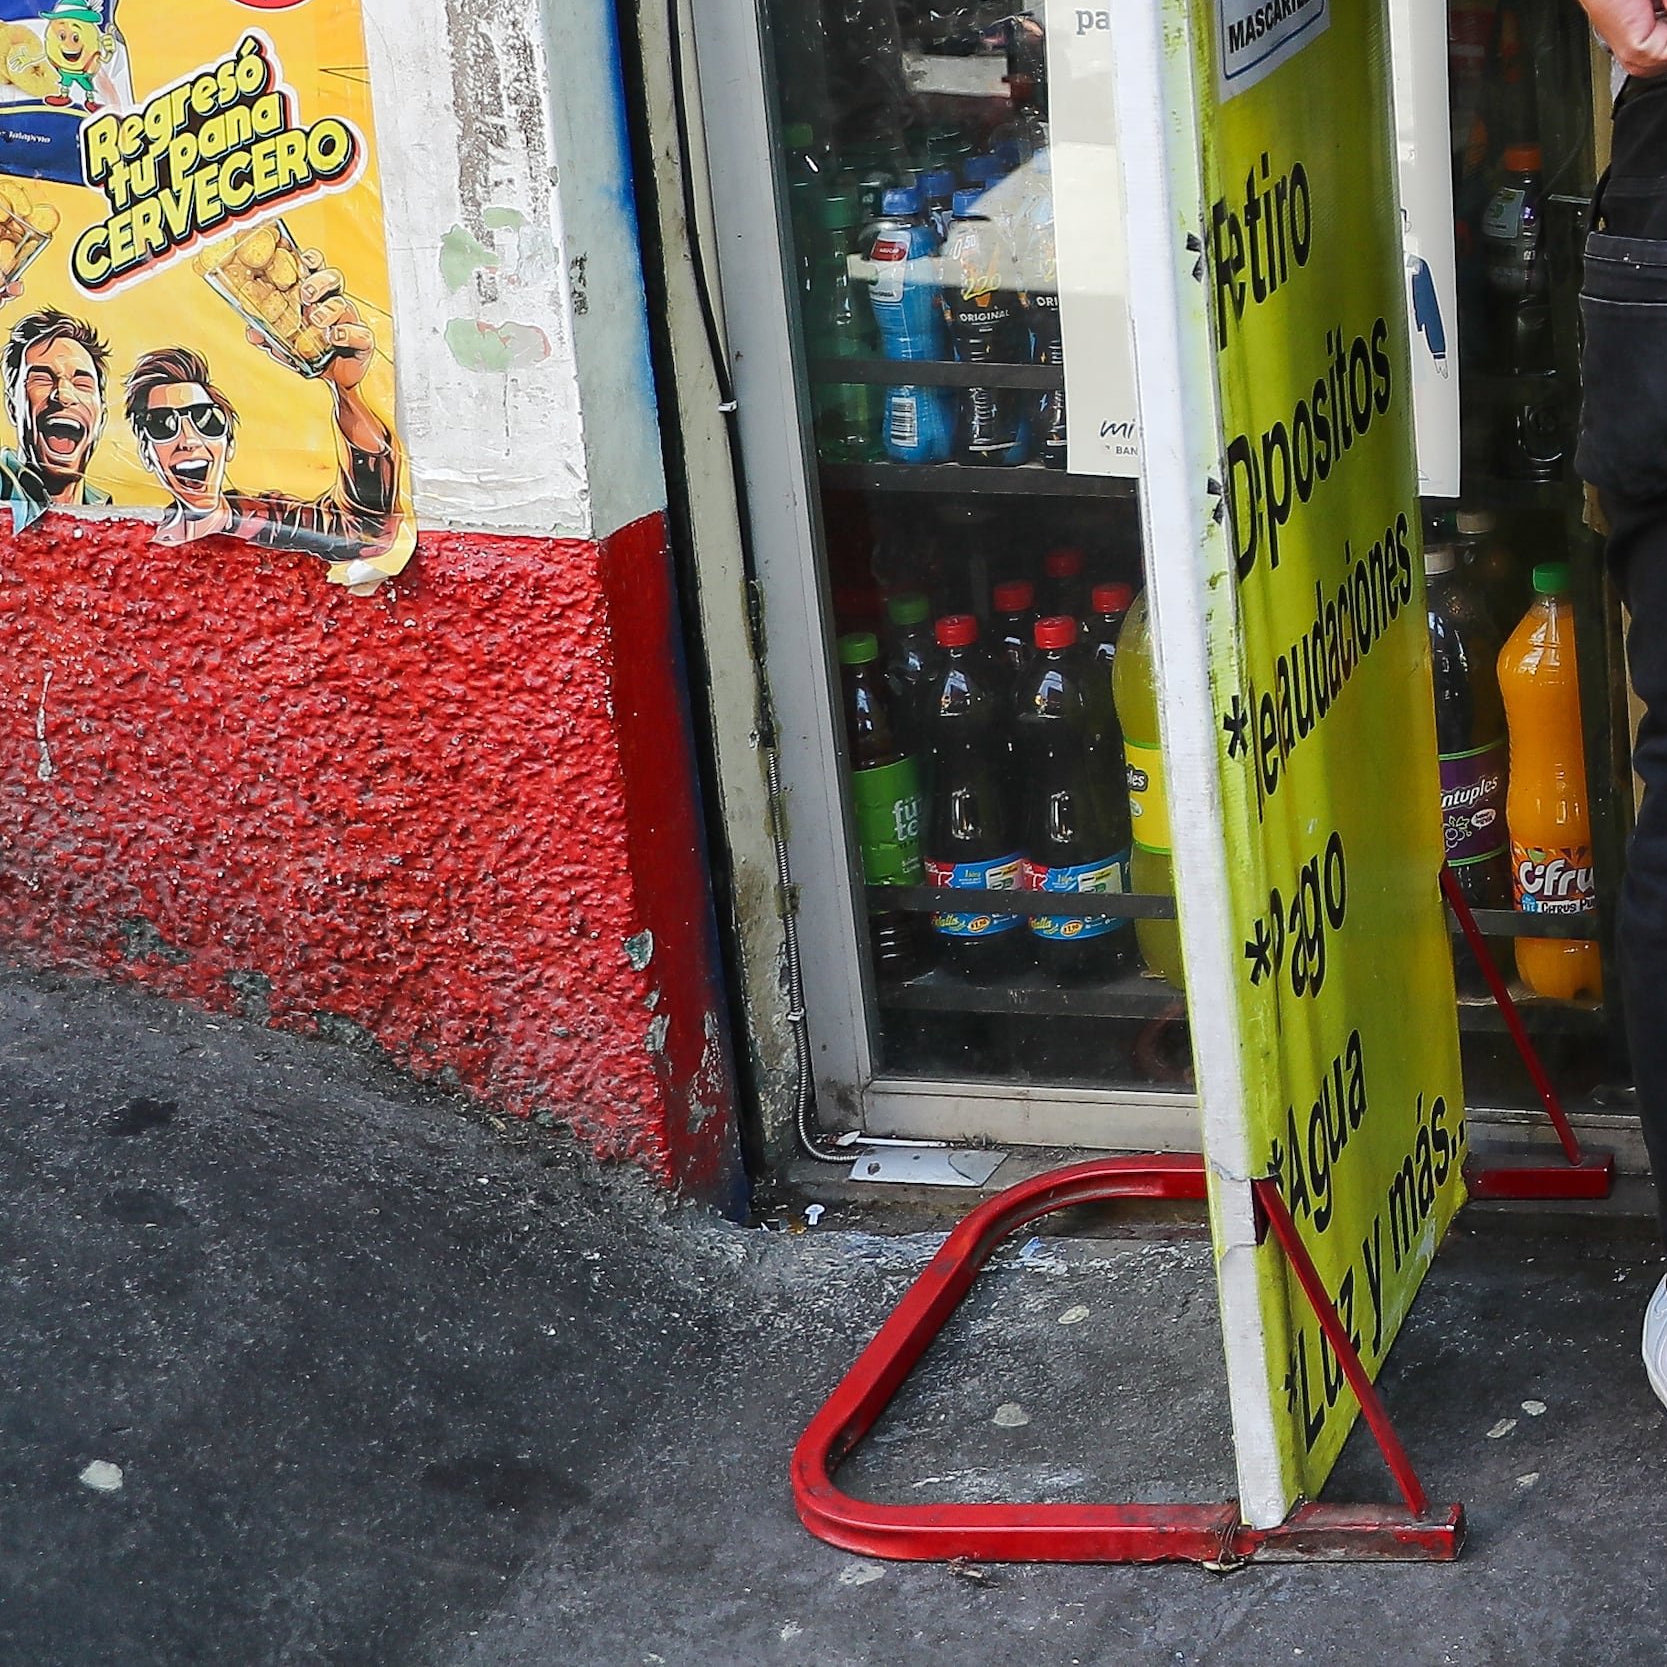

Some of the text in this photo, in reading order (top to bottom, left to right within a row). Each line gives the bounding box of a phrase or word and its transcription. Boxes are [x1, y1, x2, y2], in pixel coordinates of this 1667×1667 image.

[83, 35, 273, 176] Regresó
[105, 93, 286, 207] tu pana
[72, 119, 352, 288] CERVECERO
